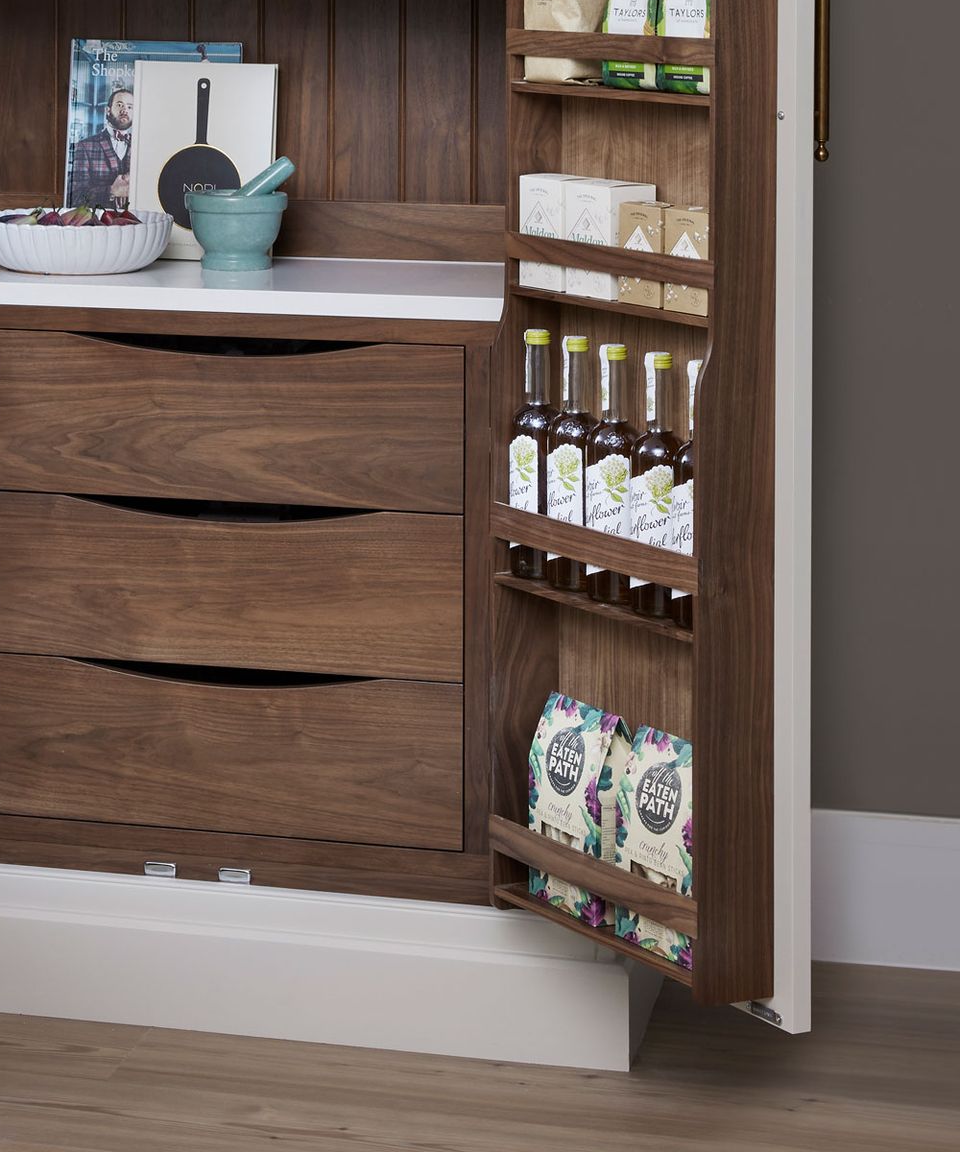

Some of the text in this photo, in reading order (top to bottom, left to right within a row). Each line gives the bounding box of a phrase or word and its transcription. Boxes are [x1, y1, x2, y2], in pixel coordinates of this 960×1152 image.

[613, 7, 646, 18] TAYLORS
[669, 7, 705, 18] TAYLORS
[92, 47, 118, 62] The
[550, 742, 583, 767] EATEN
[548, 755, 580, 783] PATH
[642, 778, 679, 804] EATEN
[547, 801, 573, 825] crunchy
[639, 792, 676, 821] PATH
[638, 840, 669, 865] crunchy
